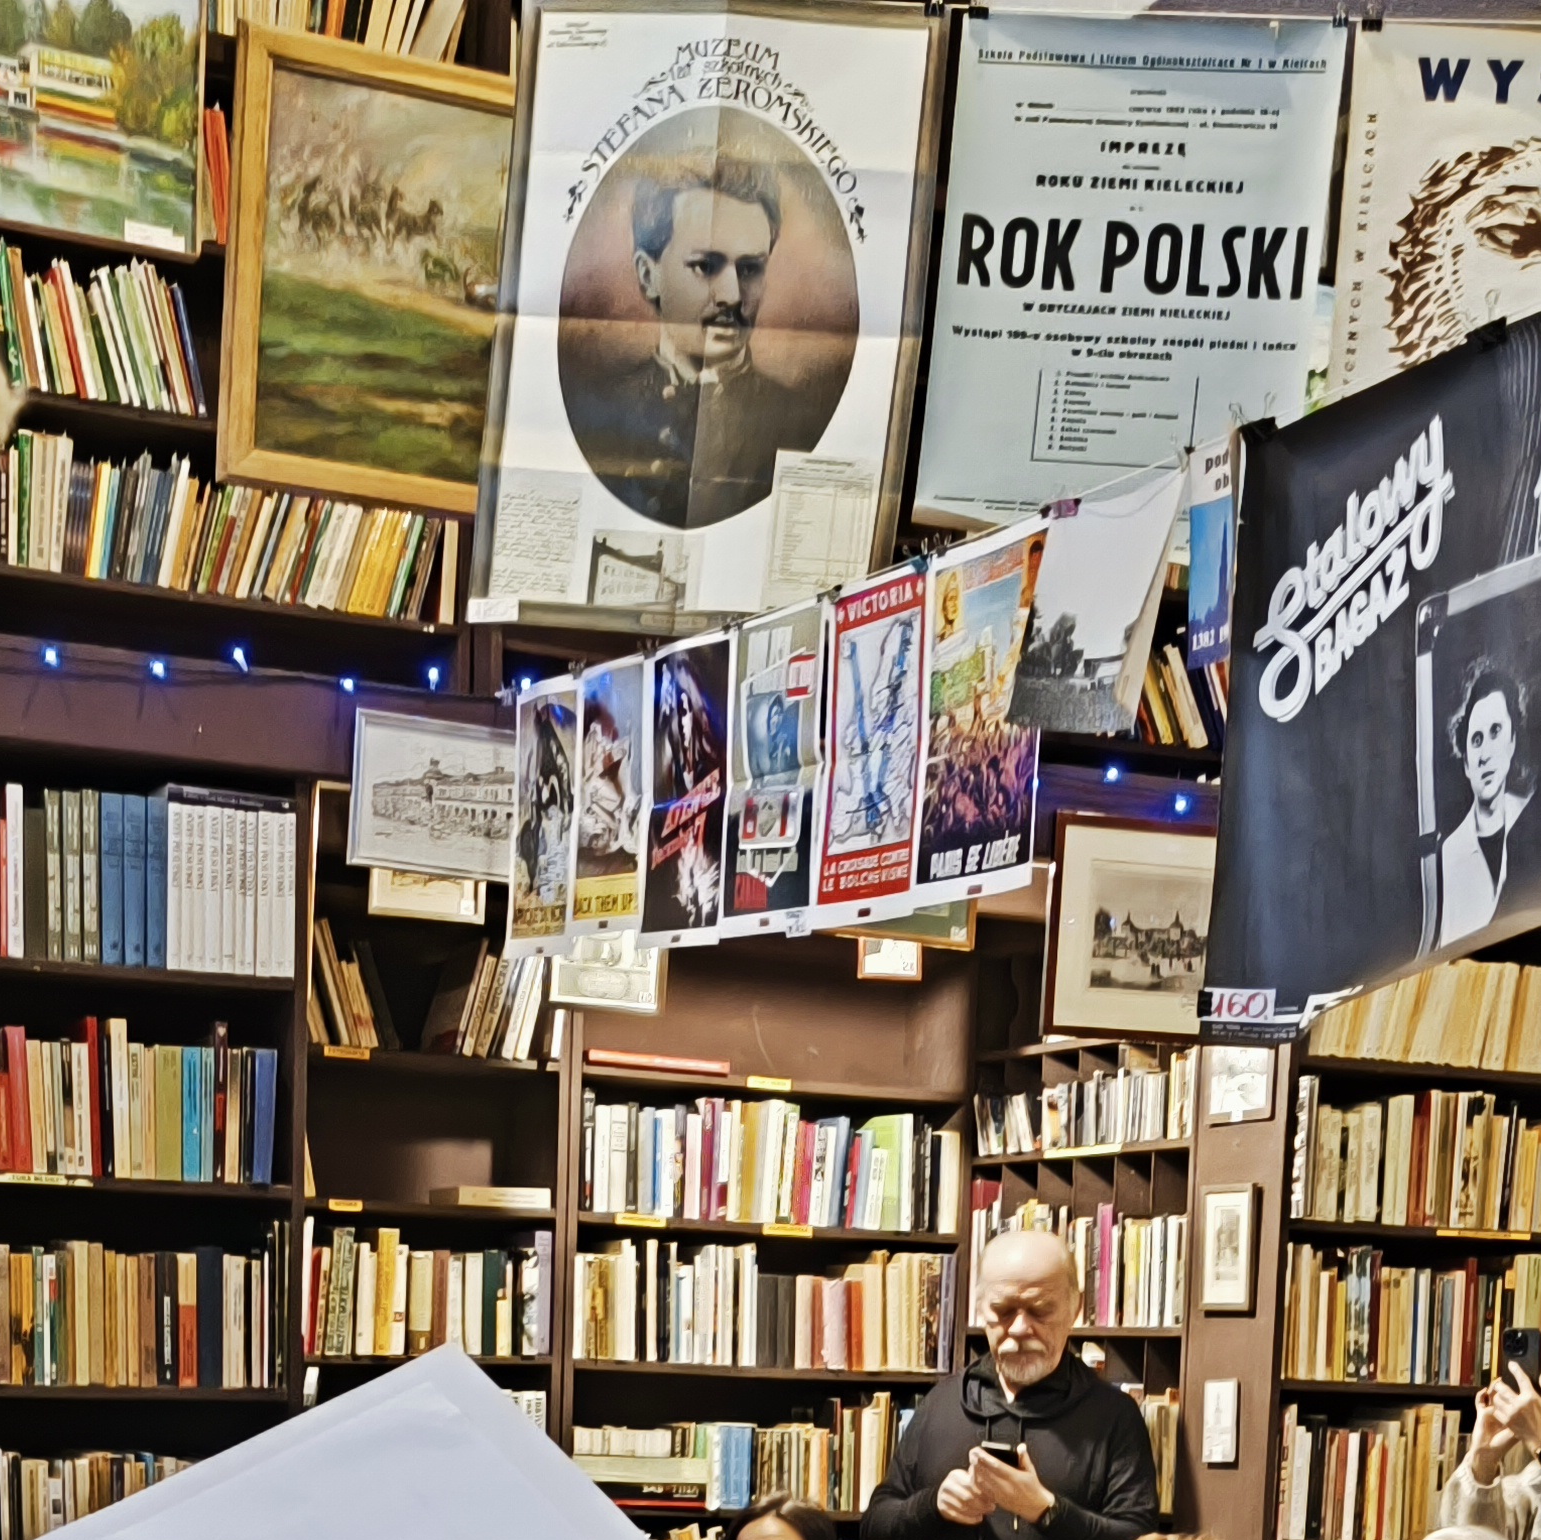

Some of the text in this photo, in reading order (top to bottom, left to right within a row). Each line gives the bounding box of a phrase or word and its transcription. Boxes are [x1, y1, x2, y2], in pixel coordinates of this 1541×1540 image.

[674, 37, 780, 69] MUZEUM
[581, 84, 686, 182] STEFANA
[1100, 140, 1186, 157] IMPREZĘ
[1035, 174, 1244, 195] ROKU ZIEMI KIELECKIEJ
[956, 212, 1309, 301] ROK POLSKI
[1121, 306, 1155, 318] ZIEMI
[1160, 308, 1231, 321] KIELECKIEJ
[1252, 412, 1456, 723] Stalowy
[846, 581, 914, 622] VICTORIA
